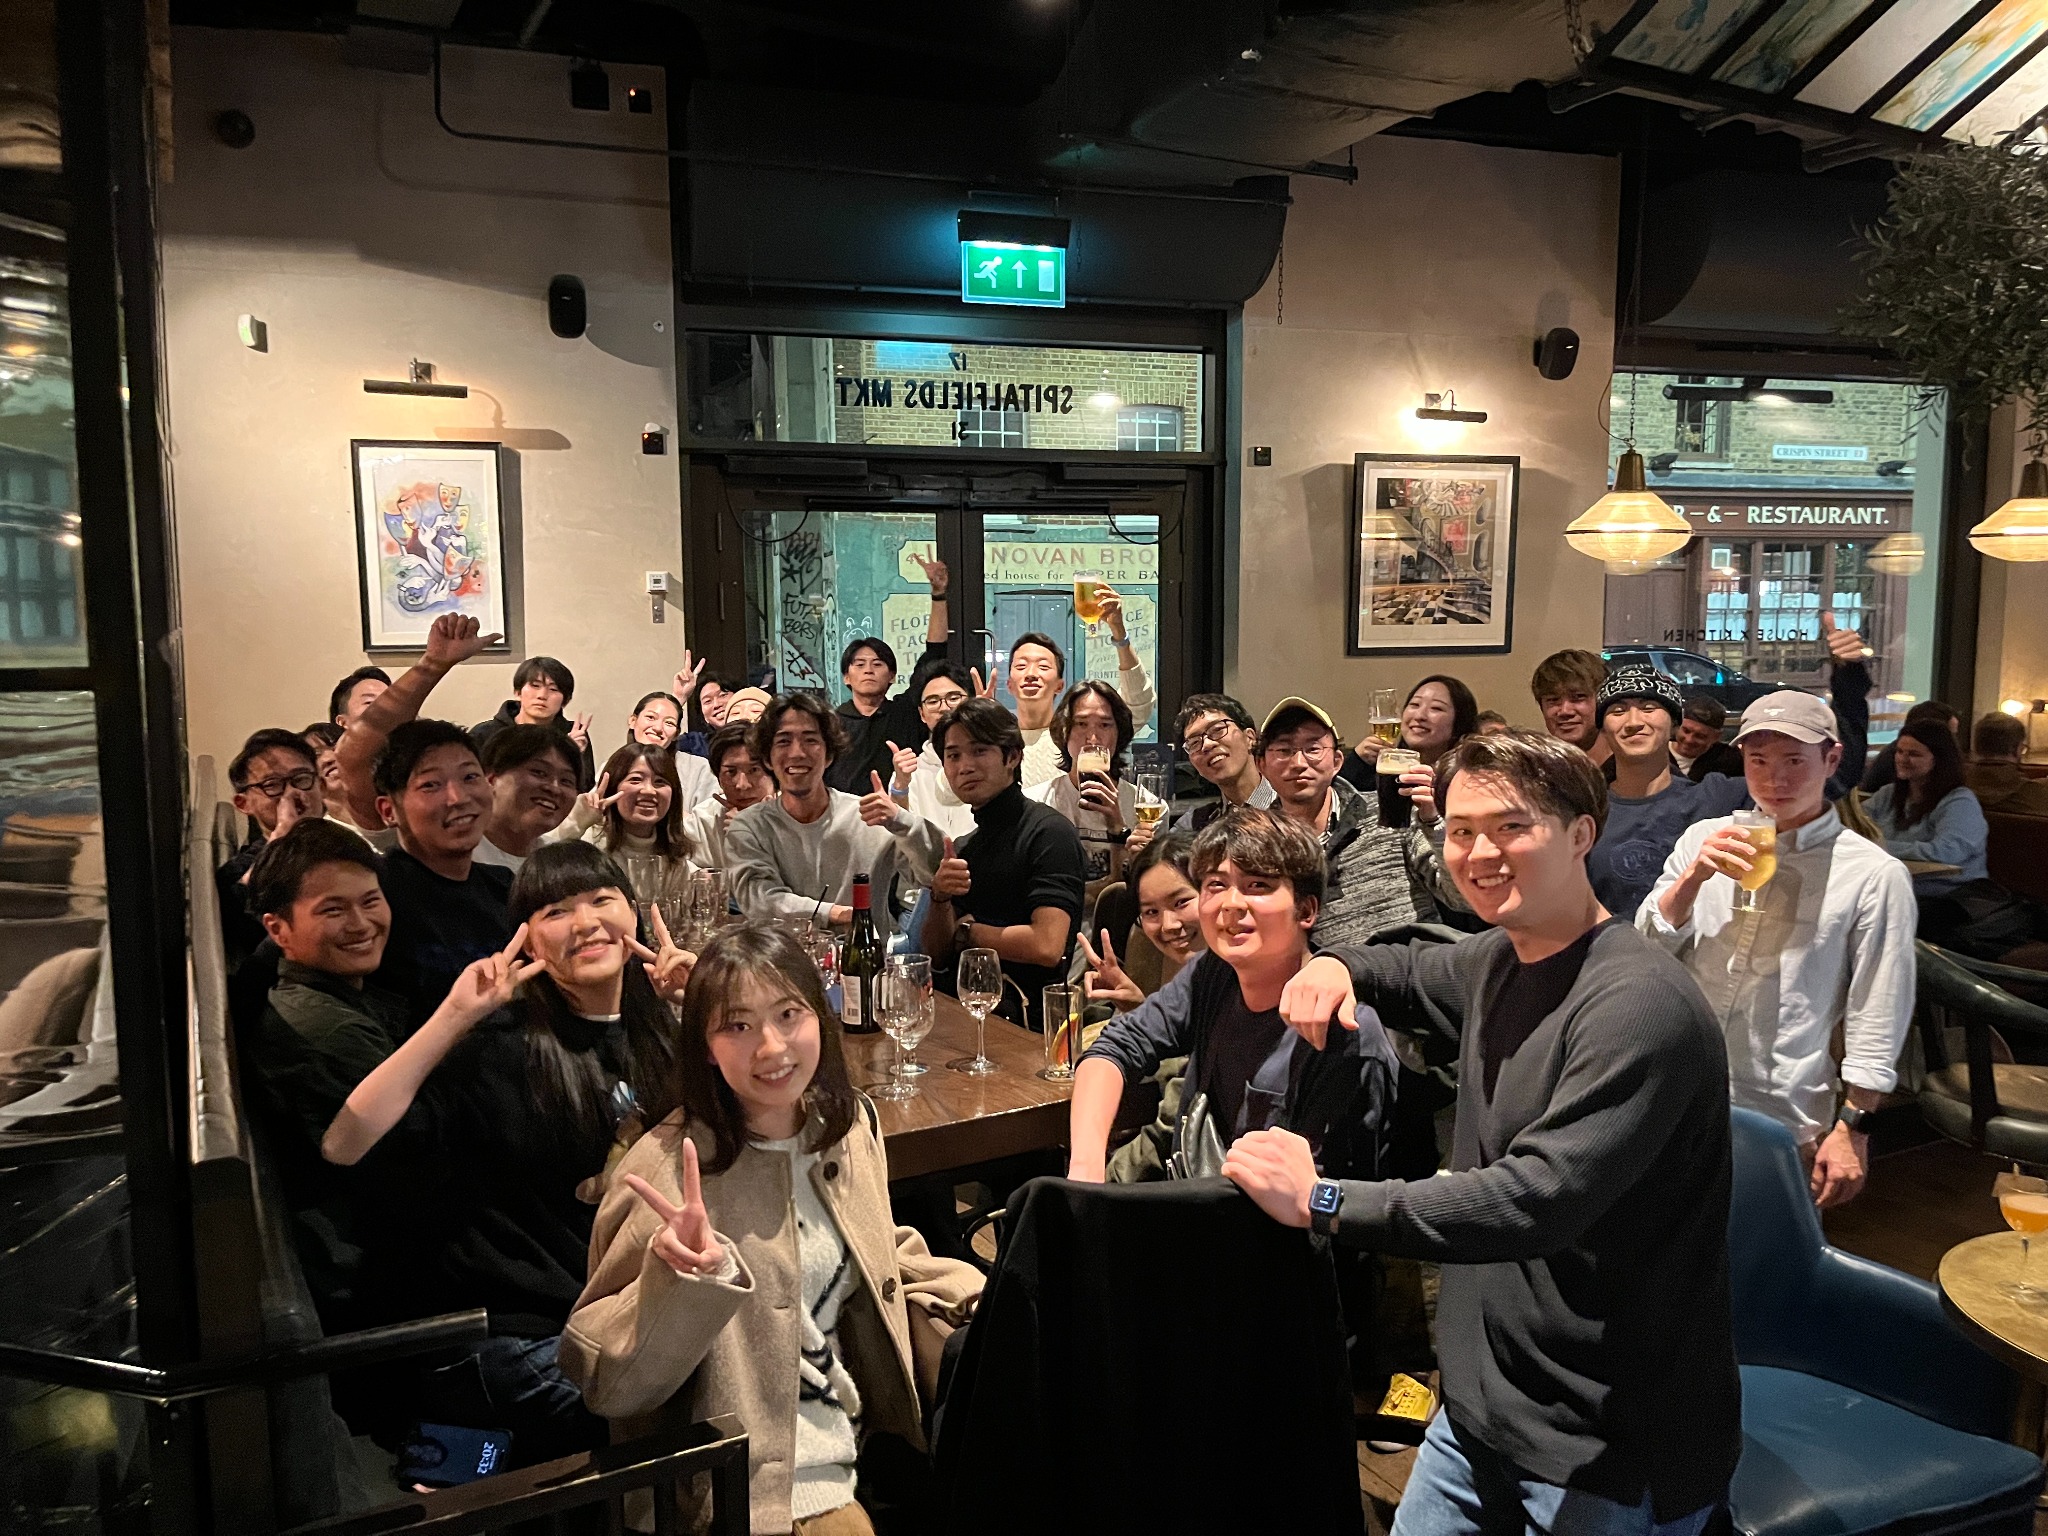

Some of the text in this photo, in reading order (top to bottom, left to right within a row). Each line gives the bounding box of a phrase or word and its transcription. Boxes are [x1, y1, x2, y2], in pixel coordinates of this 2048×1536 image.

[1776, 448, 1812, 457] CRISPIN
[1814, 449, 1848, 458] STREET
[1747, 506, 1890, 525] RESTAURANT.
[1005, 569, 1040, 581] house
[1047, 569, 1064, 581] for
[476, 1441, 494, 1474] 20:32
